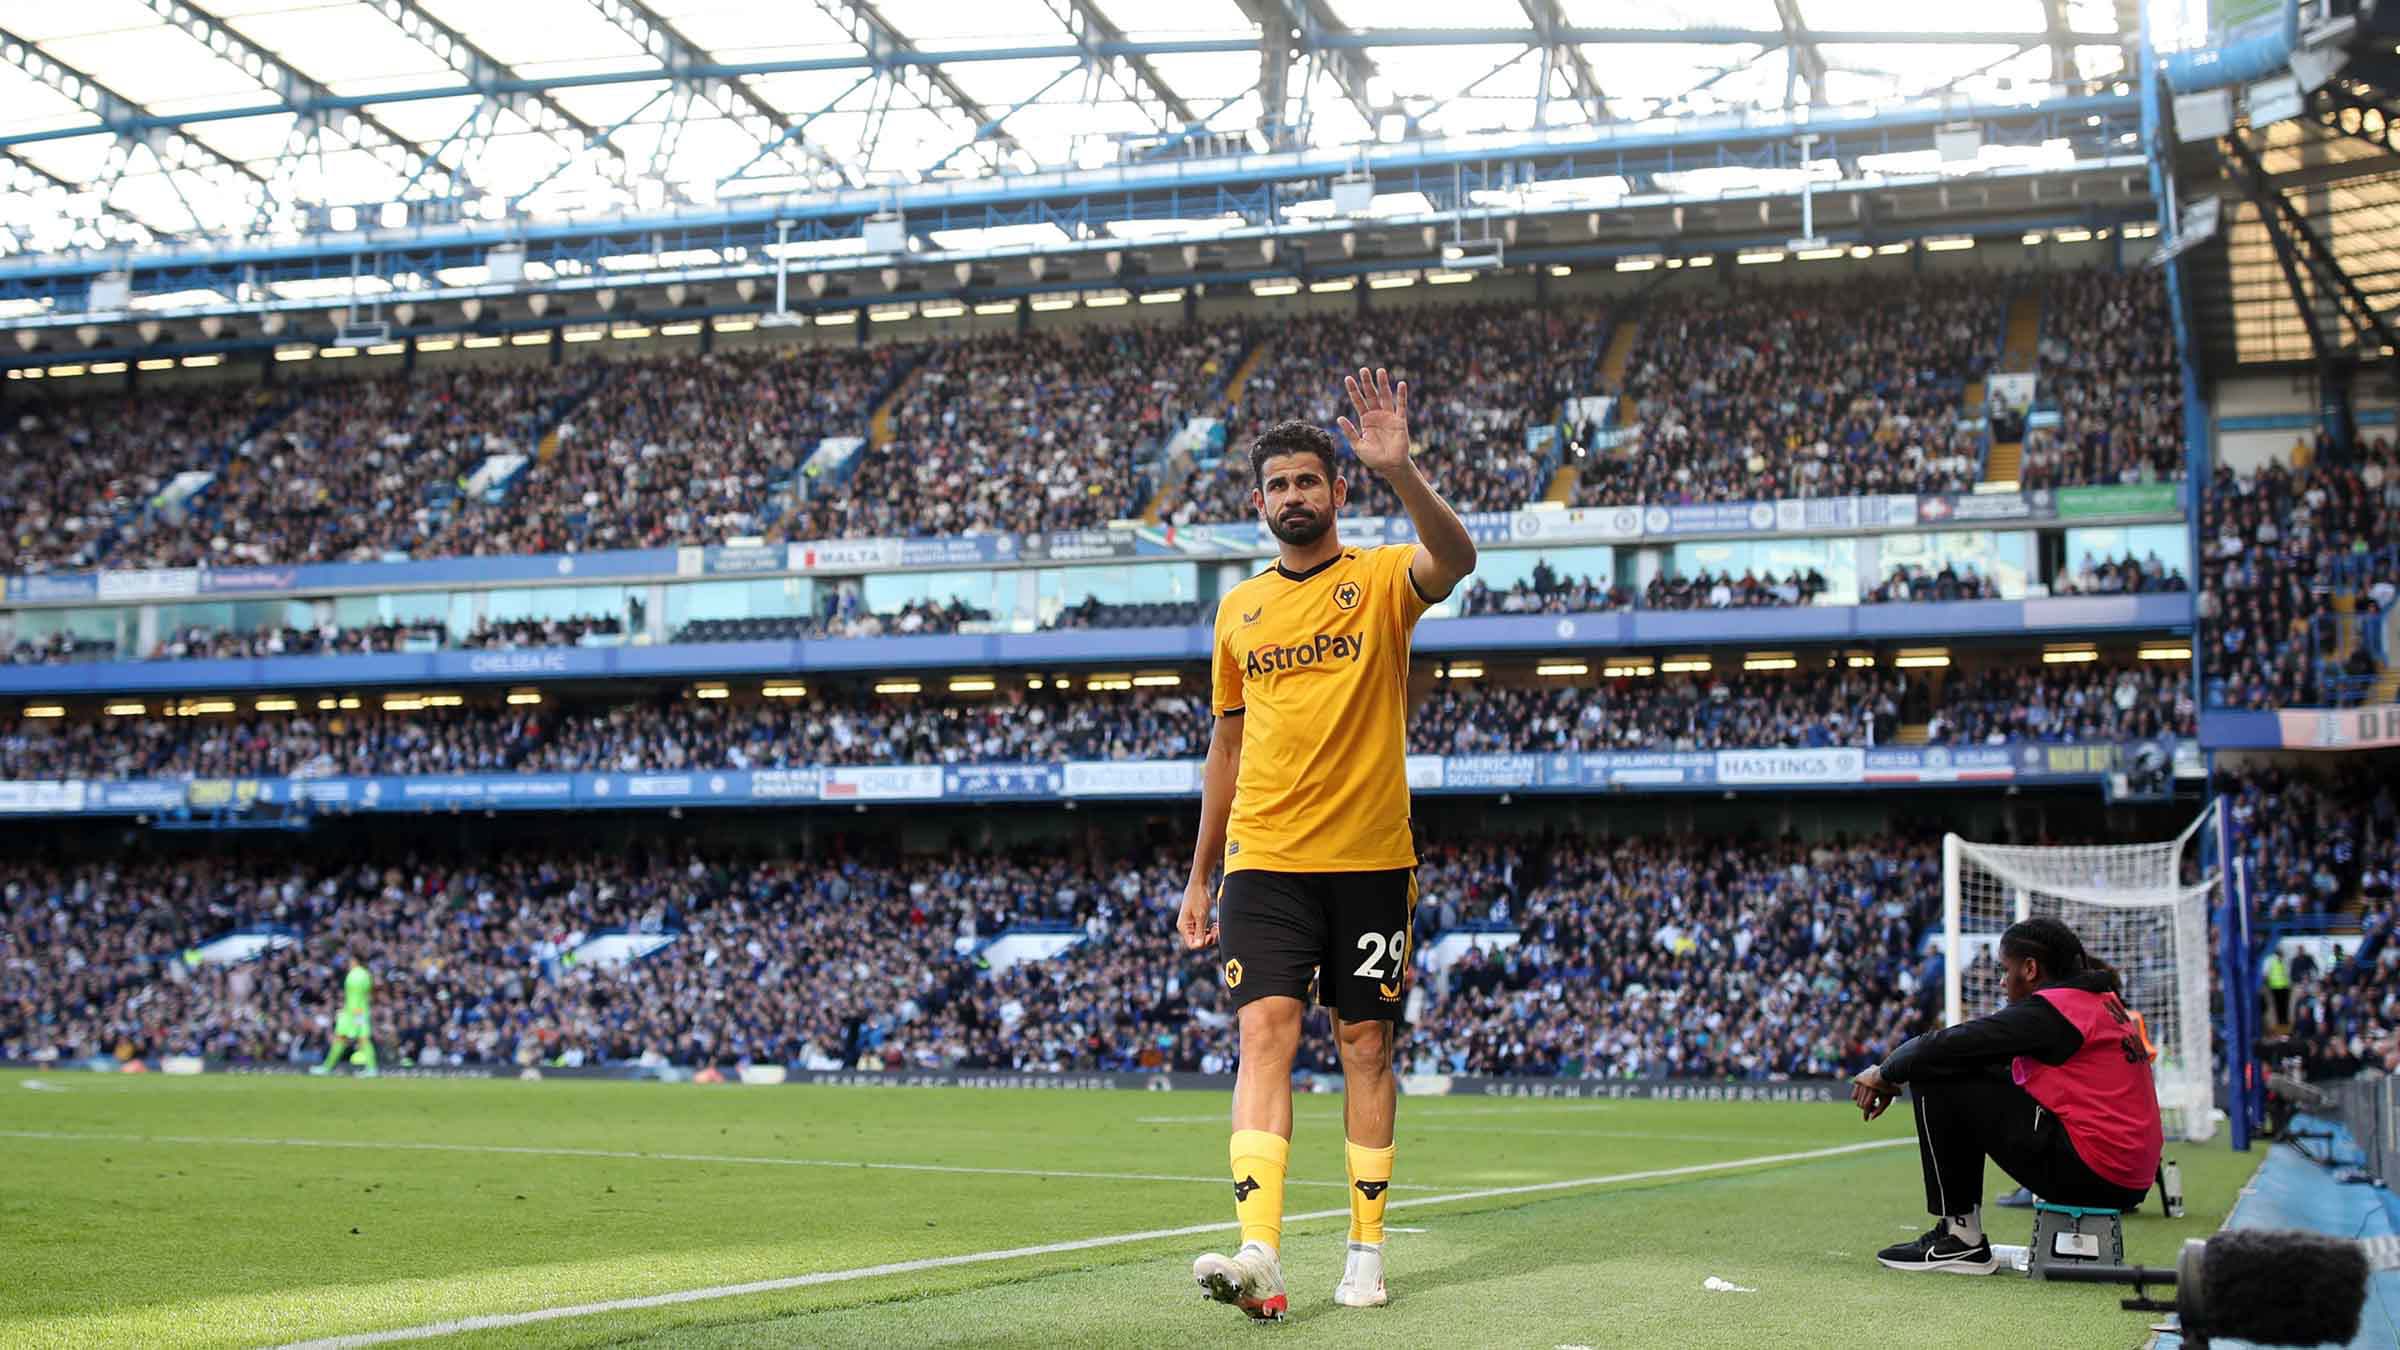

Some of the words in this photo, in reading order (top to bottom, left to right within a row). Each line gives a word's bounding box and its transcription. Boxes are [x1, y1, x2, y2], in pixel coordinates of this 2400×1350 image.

[820, 550, 882, 564] MALTA
[1246, 632, 1364, 678] AstroPay
[1446, 755, 1535, 770] AMERICAN
[1724, 758, 1828, 776] HASTINGS
[1353, 930, 1405, 979] 29
[1485, 1084, 1580, 1099] SEARCH
[1650, 1086, 1833, 1104] MEMBERSHIPS
